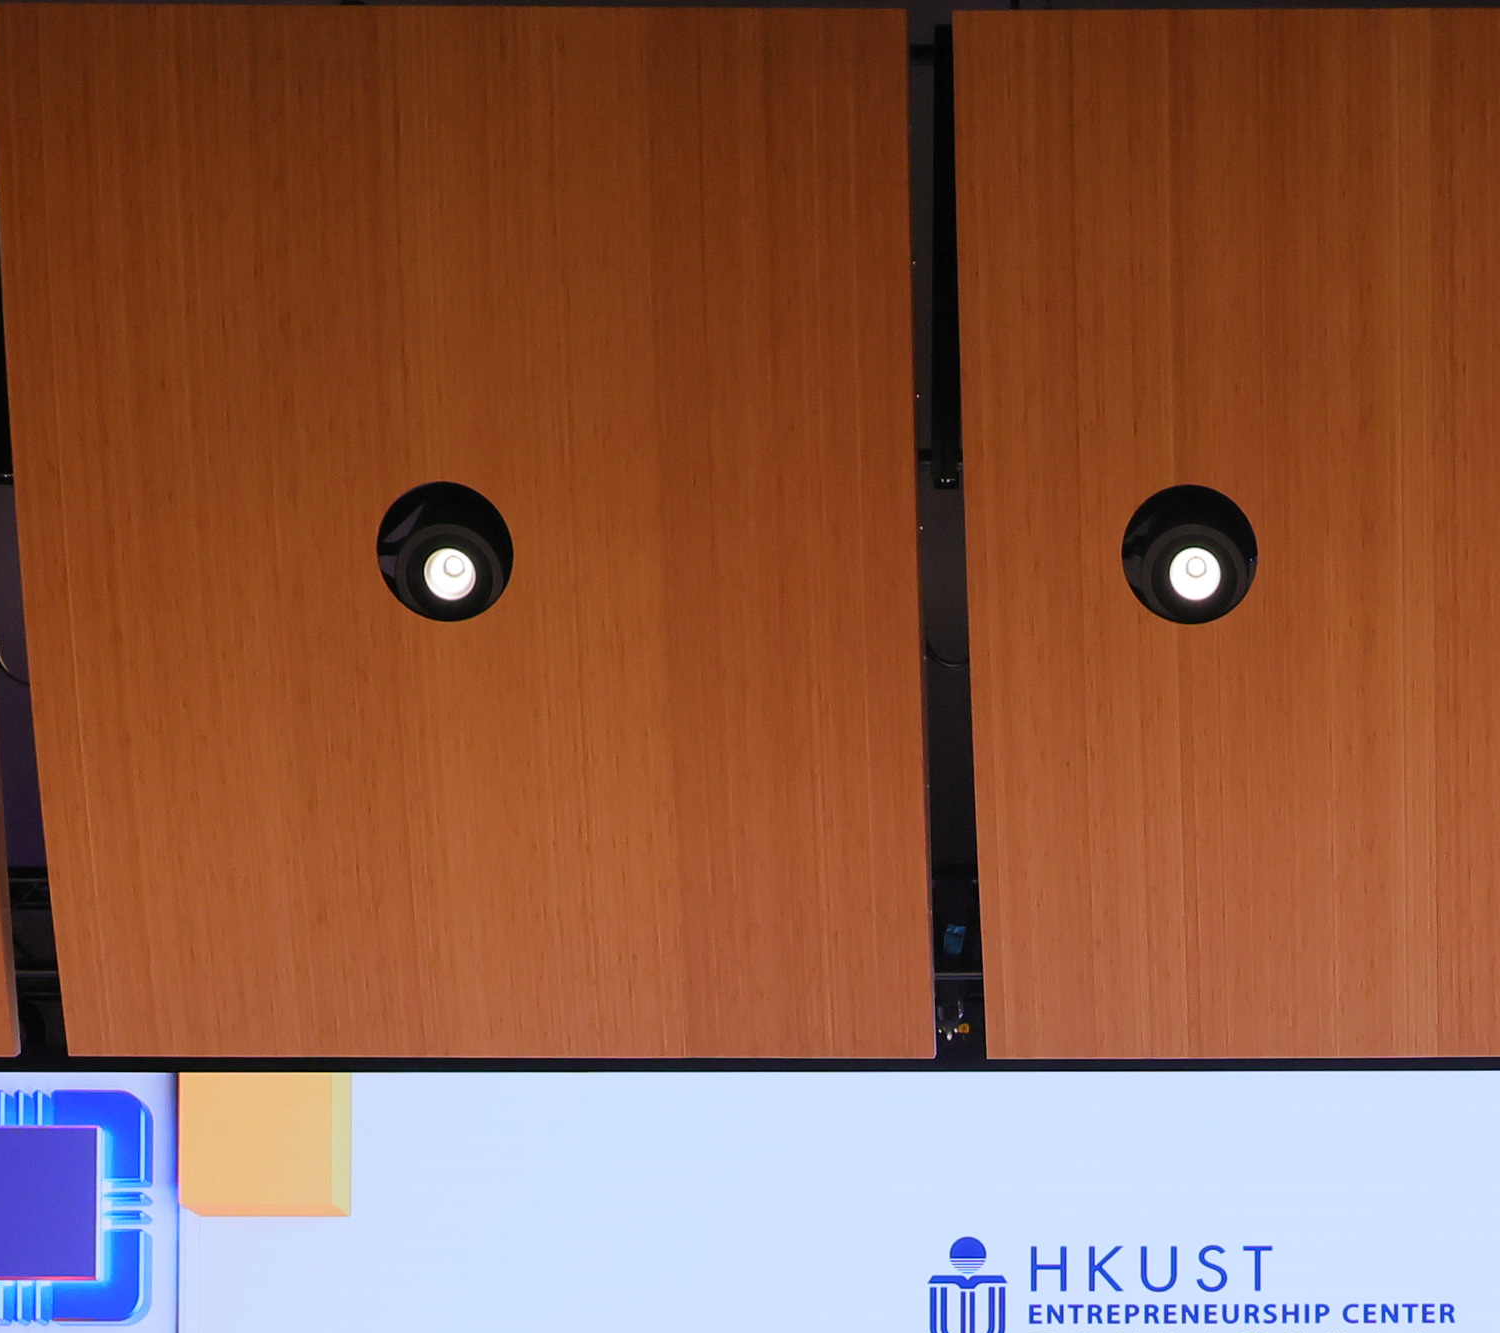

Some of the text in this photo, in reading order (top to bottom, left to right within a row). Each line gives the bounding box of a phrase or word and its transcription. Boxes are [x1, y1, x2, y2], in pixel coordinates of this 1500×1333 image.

[1030, 1244, 1274, 1293] HKUST
[1028, 1302, 1456, 1325] ENTREPRENEURSHIP CENTER
